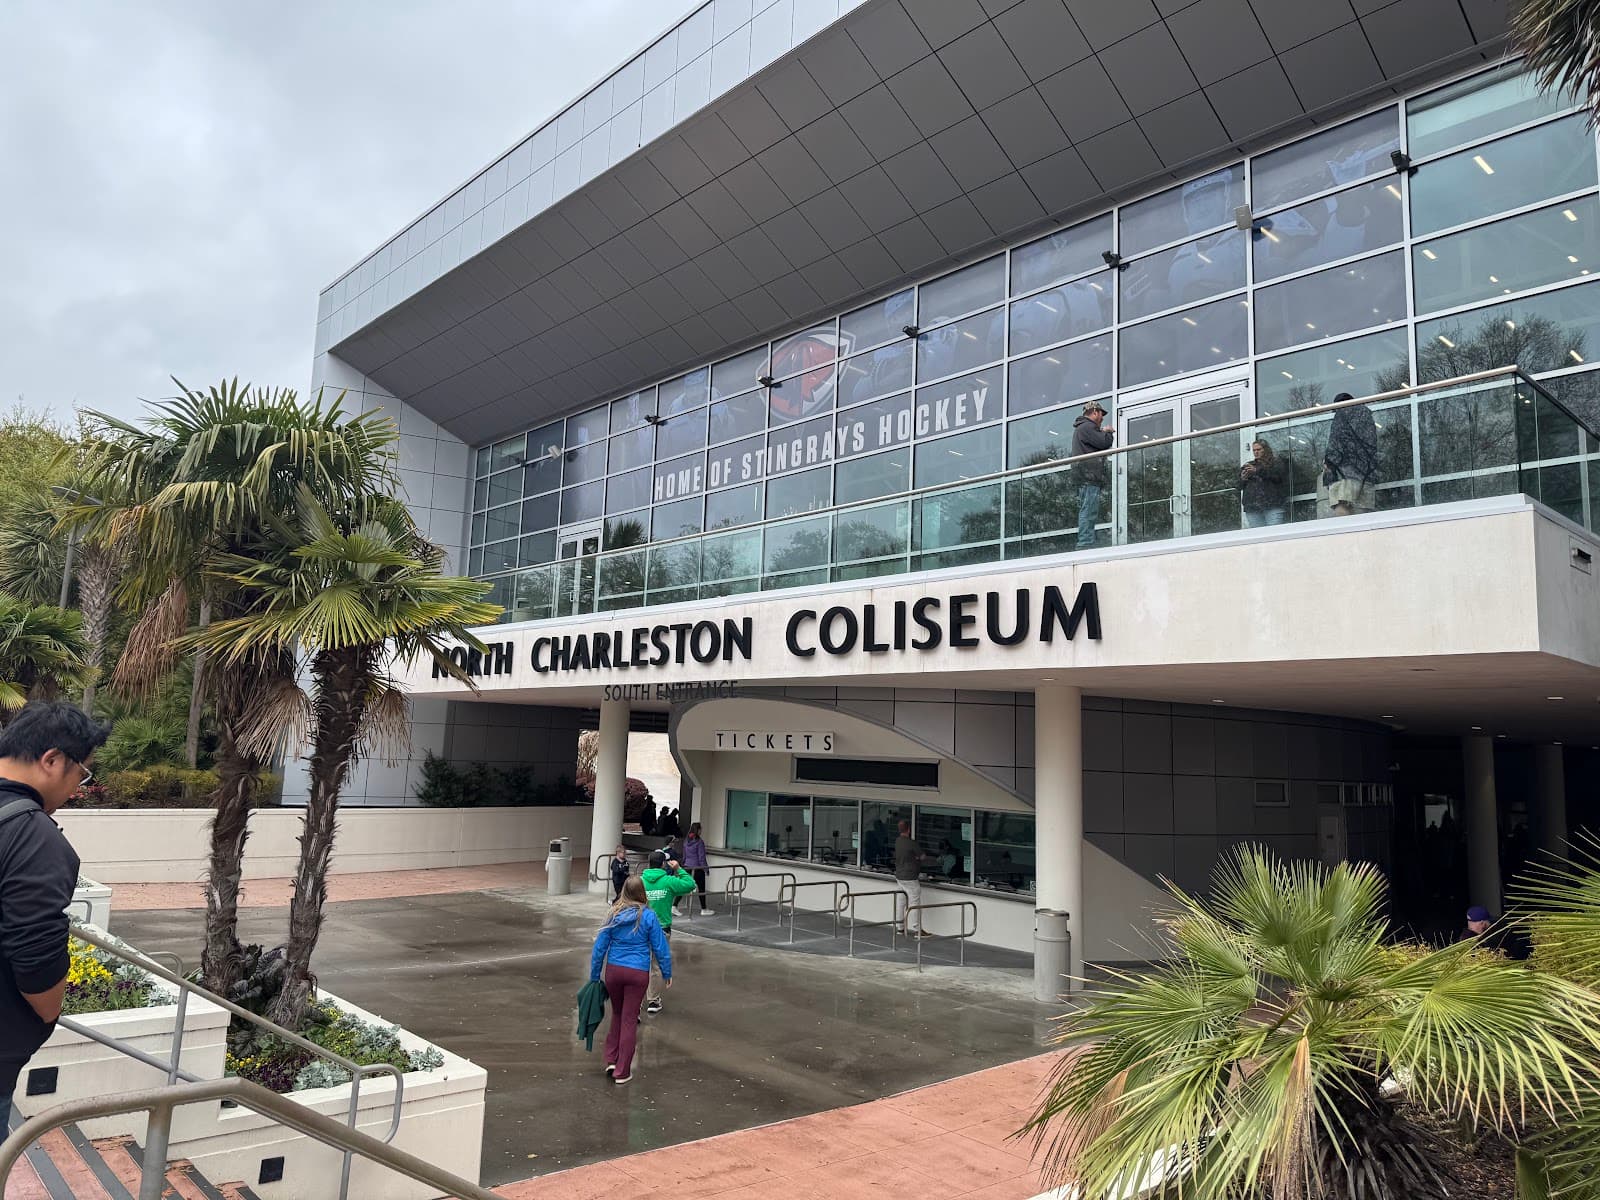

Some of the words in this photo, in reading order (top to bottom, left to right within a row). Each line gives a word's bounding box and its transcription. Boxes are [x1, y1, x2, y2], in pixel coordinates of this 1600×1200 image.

[653, 466, 701, 501] HOME
[710, 458, 731, 487] OF
[741, 422, 865, 480] STINGRAYS
[878, 387, 988, 446] HOCKEY
[431, 641, 514, 679] NORTH
[531, 617, 752, 673] CHARLESTON
[786, 582, 1103, 657] COLISEUM
[604, 684, 650, 701] SOUTH
[656, 680, 739, 700] ENTRANCE
[716, 733, 832, 751] TICKETS
